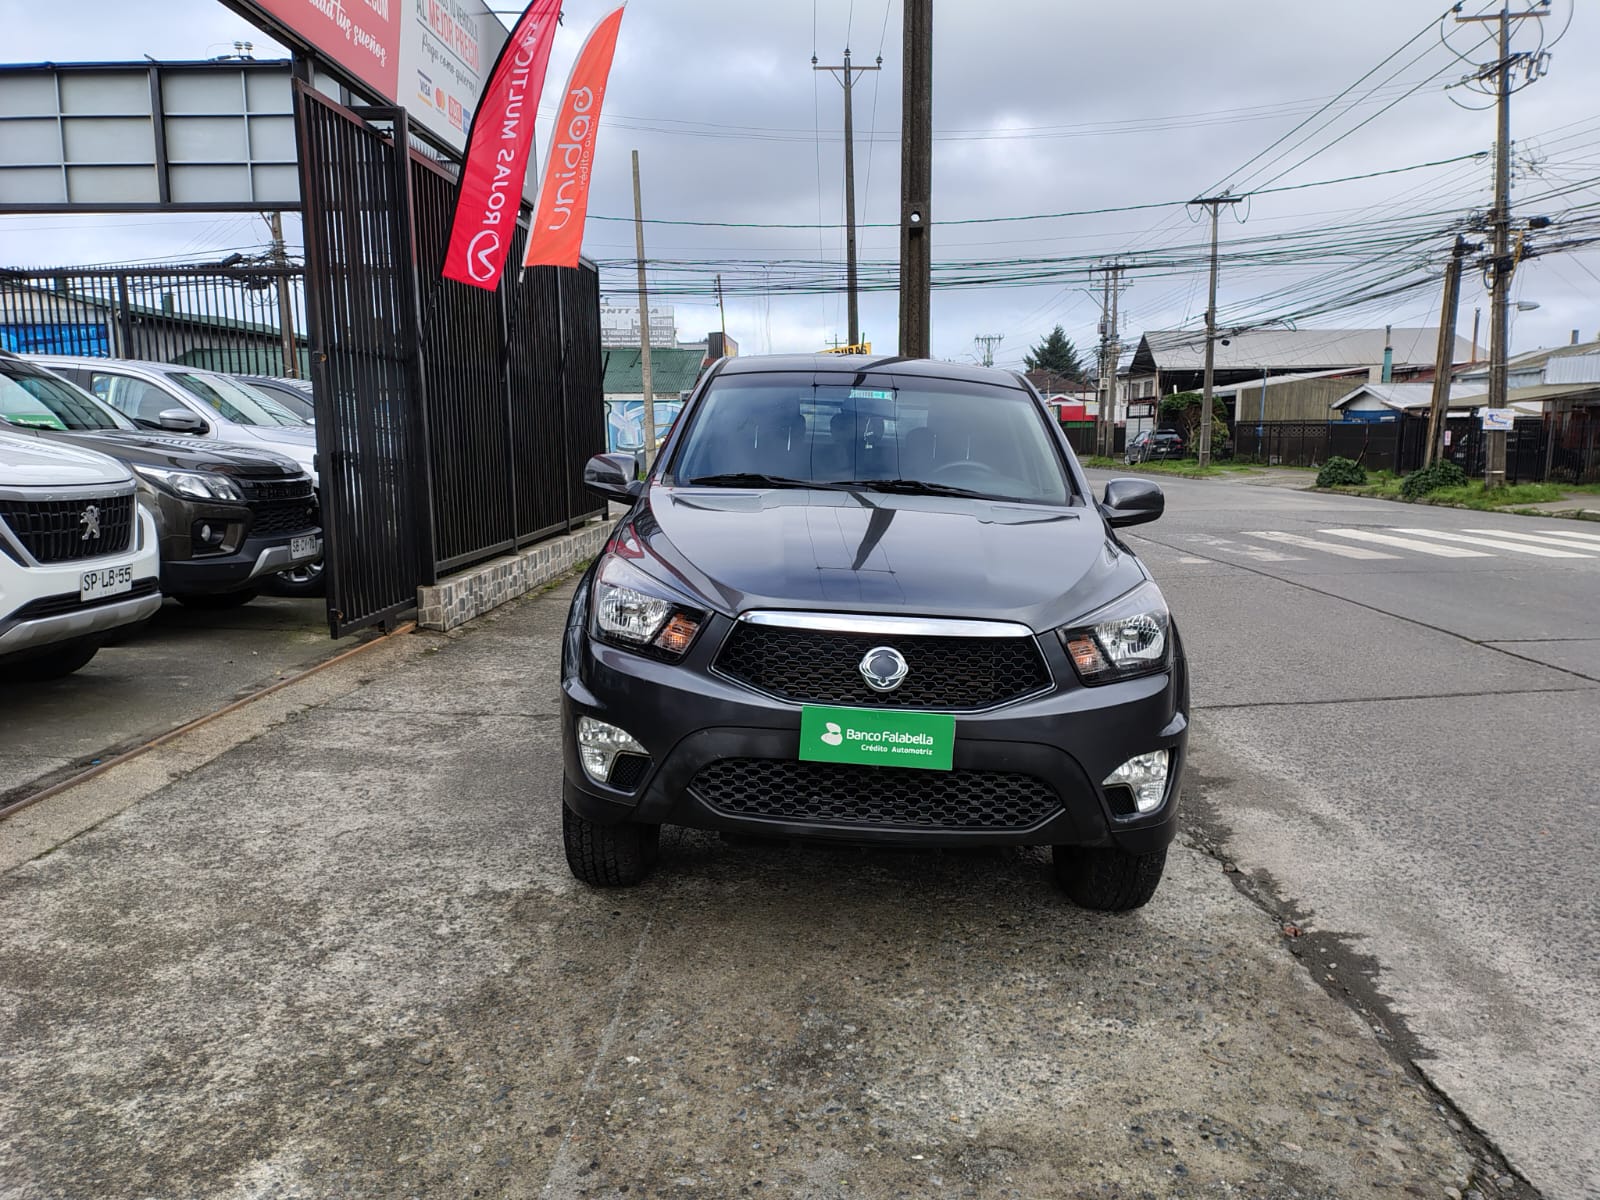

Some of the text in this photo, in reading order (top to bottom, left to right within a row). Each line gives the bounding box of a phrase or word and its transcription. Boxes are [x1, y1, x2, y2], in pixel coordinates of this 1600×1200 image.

[353, 24, 387, 68] sueños
[428, 0, 454, 49] MEJOR
[454, 23, 480, 73] PRECIO
[419, 79, 431, 97] VISA
[549, 86, 593, 230] unidad
[846, 728, 934, 746] Banco Falabella
[861, 744, 933, 756] Crédito Automotriz
